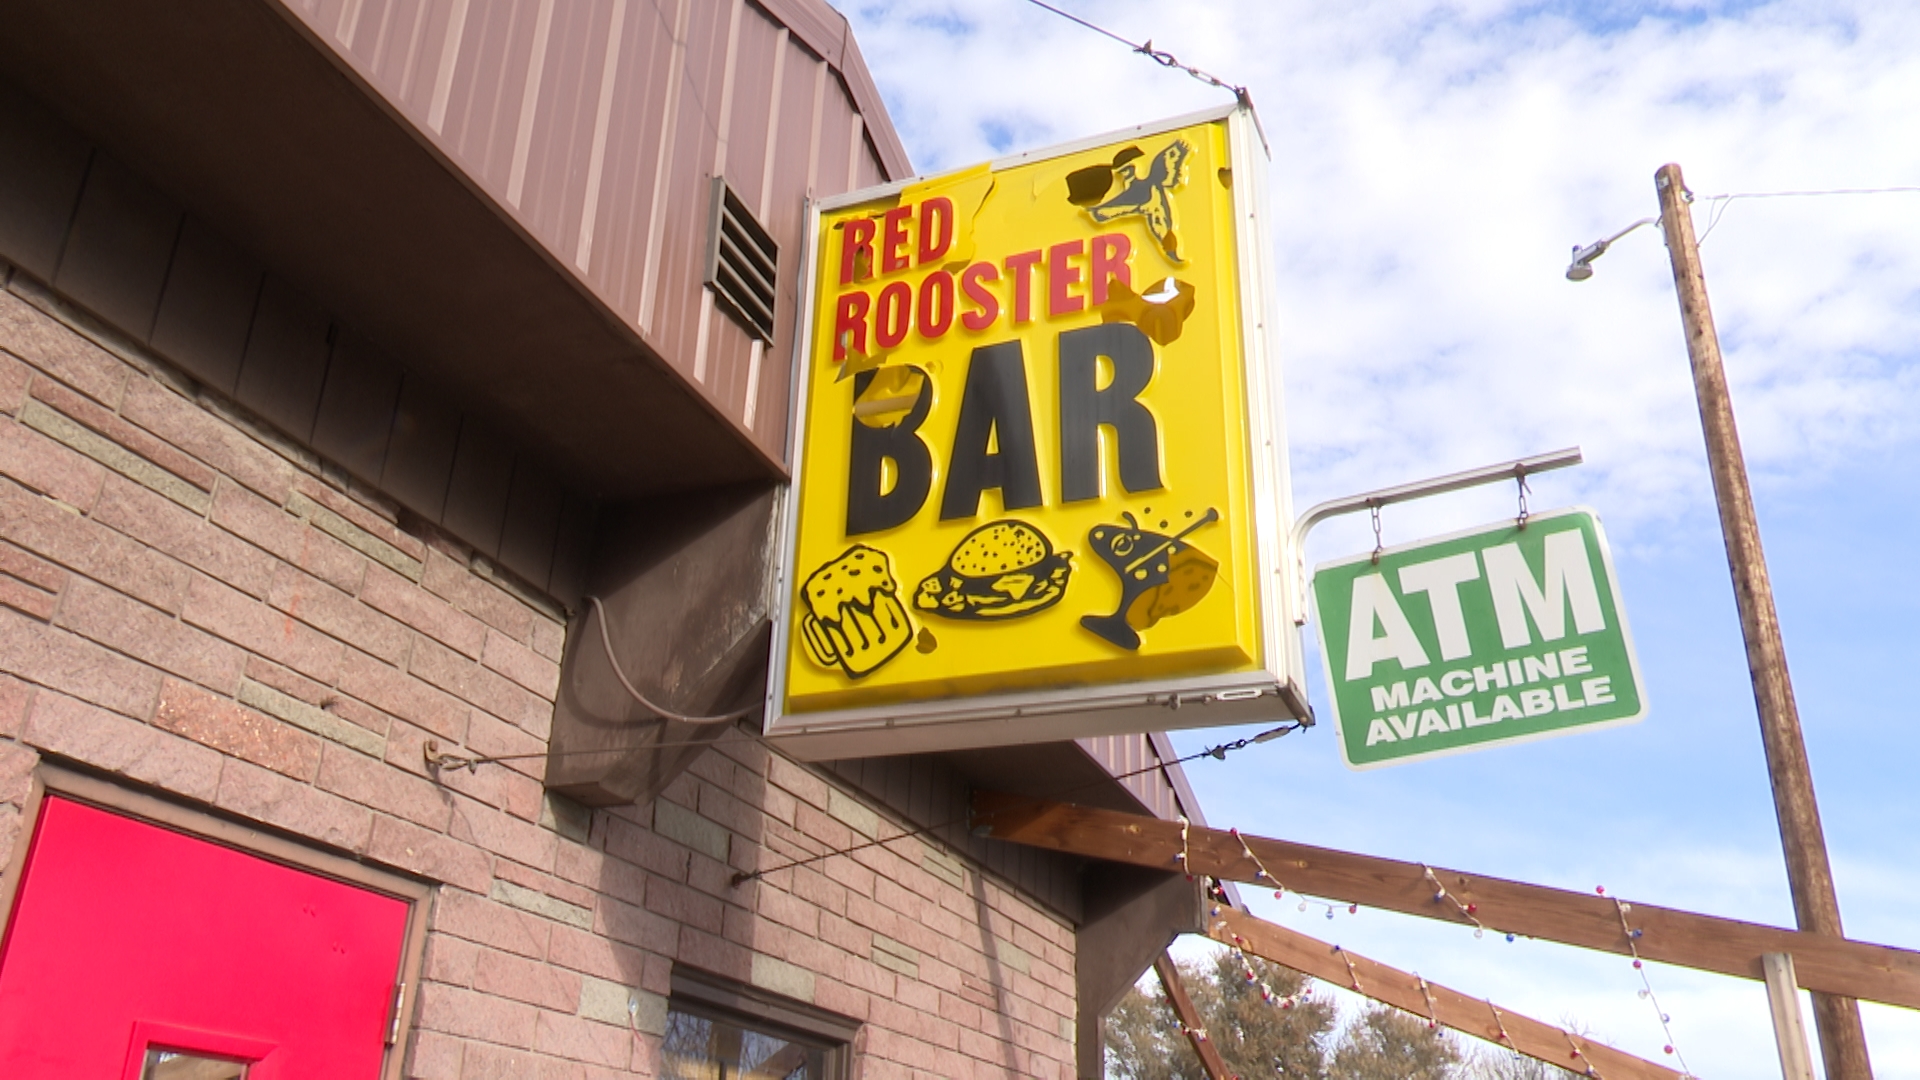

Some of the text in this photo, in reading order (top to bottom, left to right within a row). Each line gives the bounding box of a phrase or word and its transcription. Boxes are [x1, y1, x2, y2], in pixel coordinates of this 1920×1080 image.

[840, 196, 954, 286] RED
[833, 232, 1133, 363] ROOSTER
[846, 322, 1165, 537] BAR
[1345, 528, 1606, 682] ATM
[1365, 675, 1616, 747] AVAILABLE
[1370, 646, 1593, 712] MACHINE
